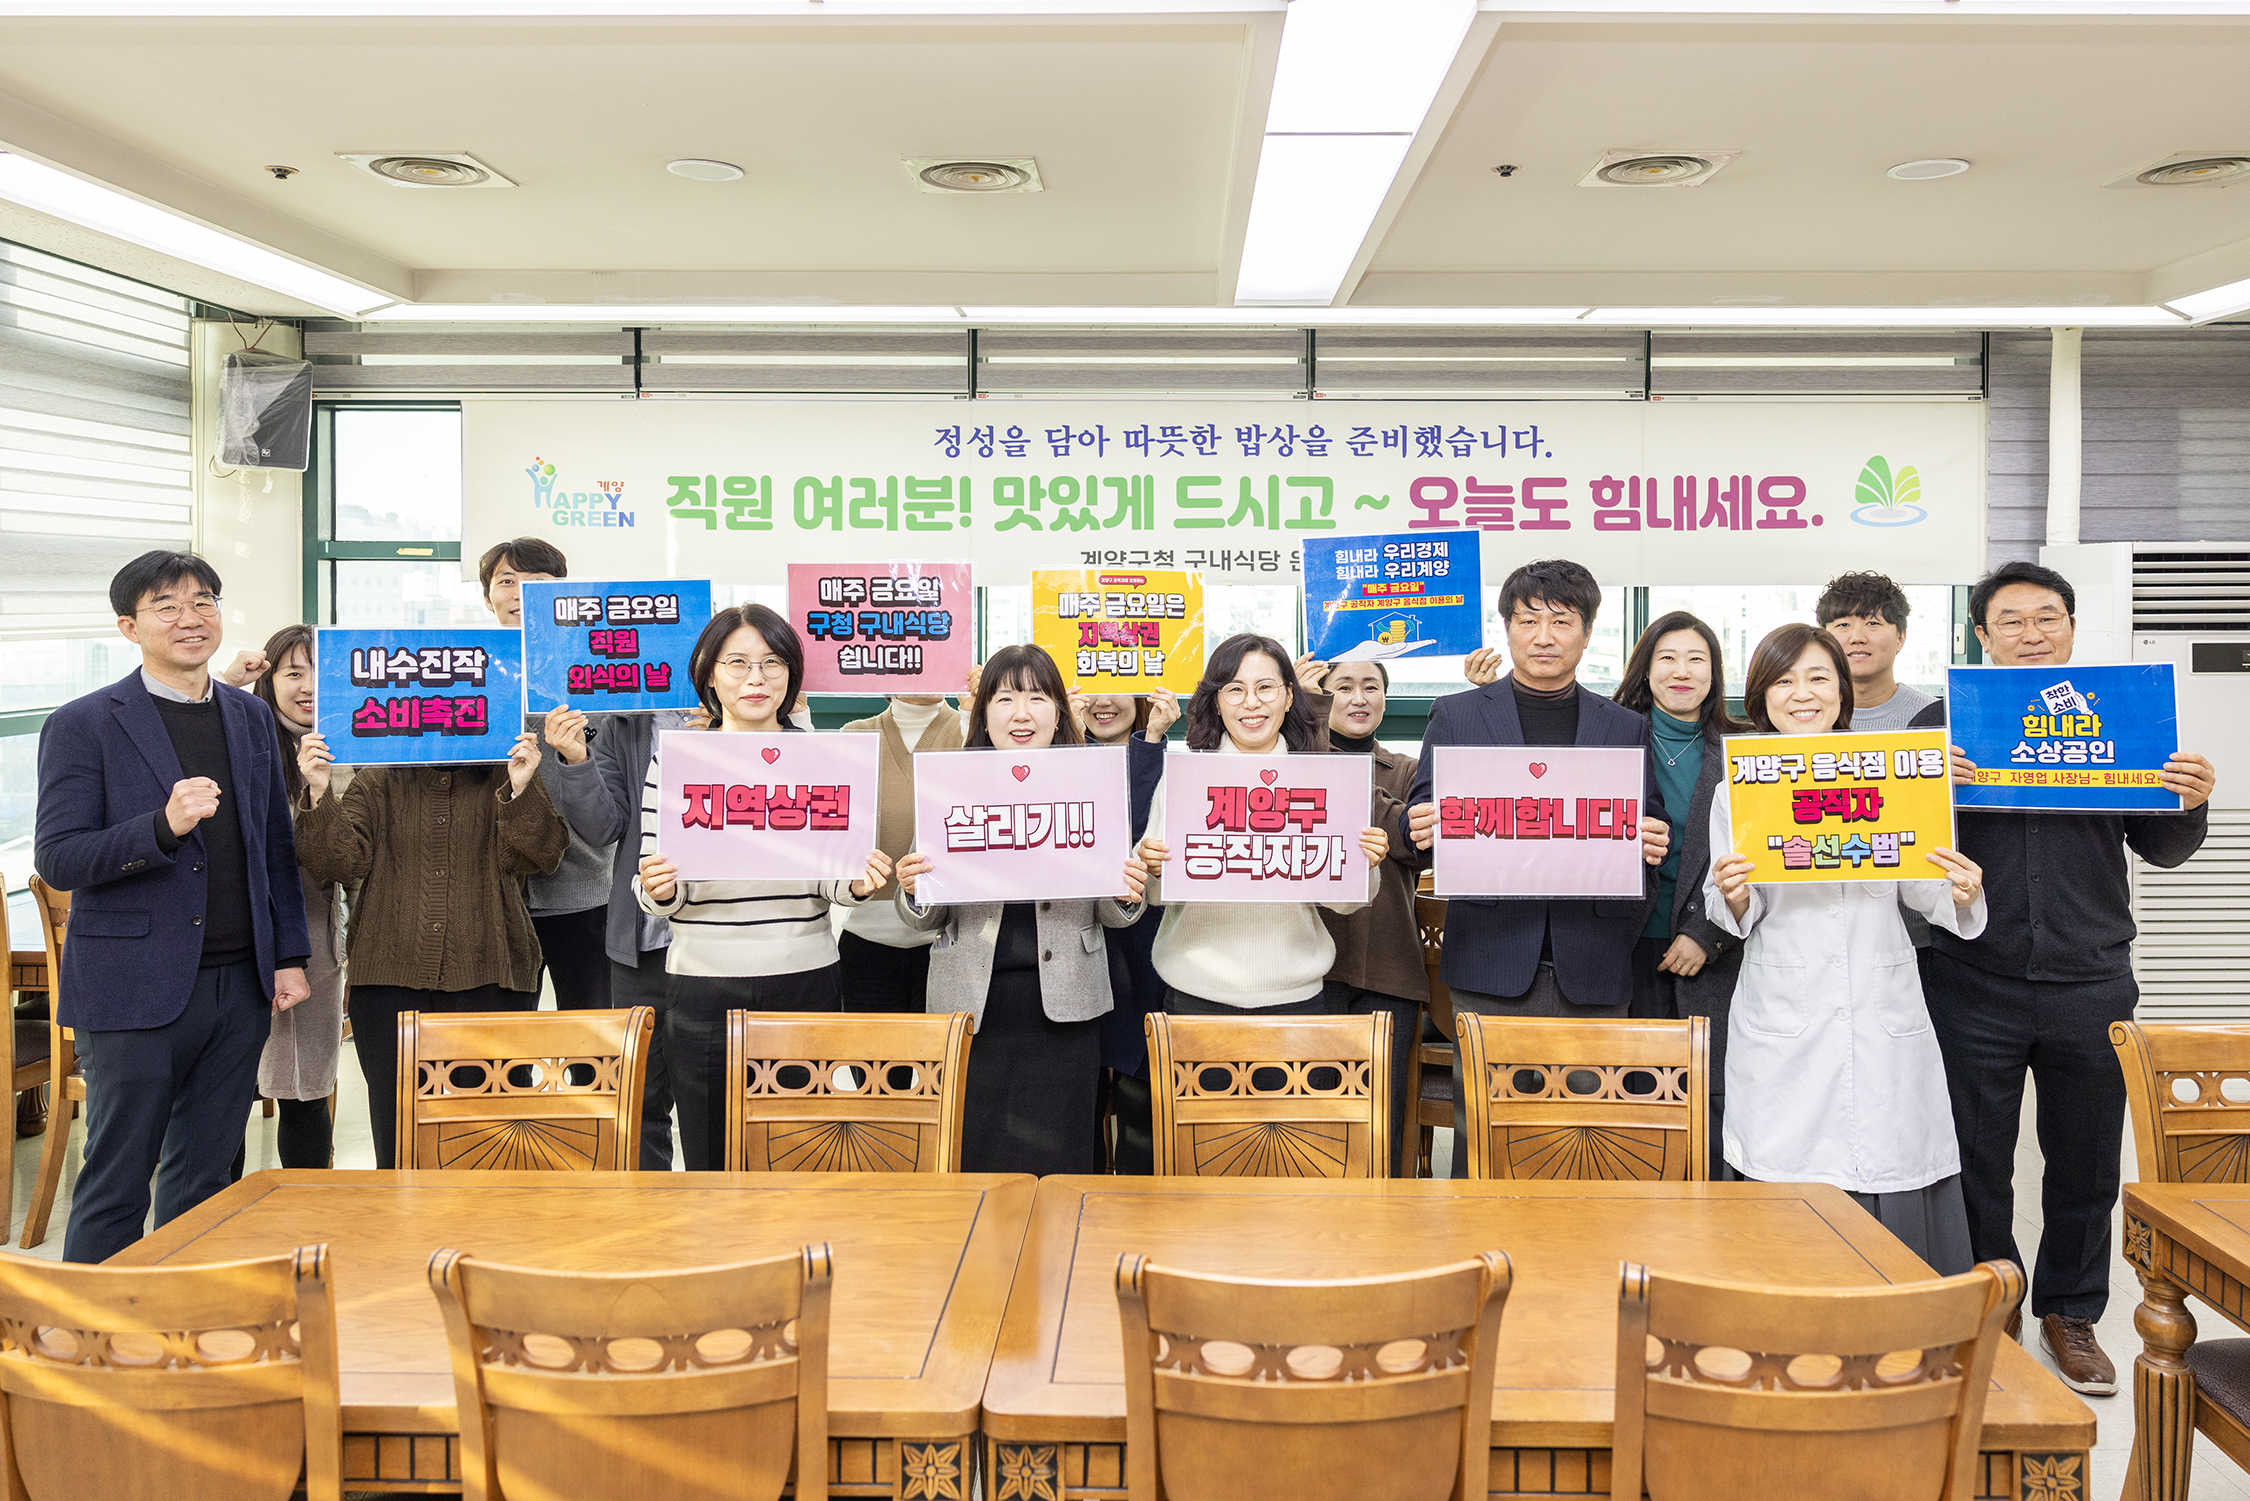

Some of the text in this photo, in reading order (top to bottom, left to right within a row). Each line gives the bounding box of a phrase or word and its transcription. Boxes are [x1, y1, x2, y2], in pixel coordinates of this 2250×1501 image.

[933, 423, 1553, 459] 정성을 담아 따뜻한 밥상을 준비했습니다.
[596, 480, 625, 493] 계양
[666, 474, 774, 531] 직원
[793, 474, 972, 531] 여러분!
[993, 474, 1155, 532] 맛있게
[1173, 474, 1337, 530] 드시고
[1408, 476, 1571, 531] 오늘도
[1588, 474, 1824, 532] 힘내세요.
[552, 511, 635, 528] GREEN
[1184, 550, 1281, 572] 구내식당
[1335, 541, 1449, 564] 힘내라 우리경제
[1336, 560, 1450, 580] 힘내라 우리계양
[819, 576, 941, 607] 매주 금요일
[1351, 600, 1374, 608] 공직자
[1377, 599, 1400, 607] 계양구
[1403, 597, 1427, 606] 음식점
[1363, 581, 1425, 594] "매주 금요일"
[554, 594, 680, 626] 매주 금요일
[1058, 592, 1186, 619] 매주 금요일은
[807, 610, 952, 641] 구청 구내식당
[1078, 622, 1160, 648] 지역상권
[589, 628, 639, 658] 직원
[351, 646, 490, 688] 내수진작
[838, 645, 923, 675] 쉽니다!!
[1076, 650, 1165, 677] 회복의 날
[567, 662, 671, 694] 외식의 날
[2045, 685, 2071, 699] 착한
[352, 695, 490, 737] 소비촉진
[2053, 696, 2077, 713] 소비
[2021, 713, 2103, 738] 힘내라
[1732, 748, 1944, 784] 계양구 음식점 이용
[2010, 740, 2116, 764] 소상공인
[1973, 771, 2001, 783] 양구
[2010, 772, 2047, 784] 자영업
[2053, 772, 2099, 785] 사장님~
[681, 784, 851, 831] 지역상권
[1206, 786, 1328, 832] 계양구
[1439, 796, 1637, 840] 함께합니다!
[1792, 787, 1884, 824] 공직자
[945, 801, 1096, 853] 살리기!!
[1185, 834, 1346, 881] 공직자가
[1768, 831, 1915, 870] "솔선수범"
